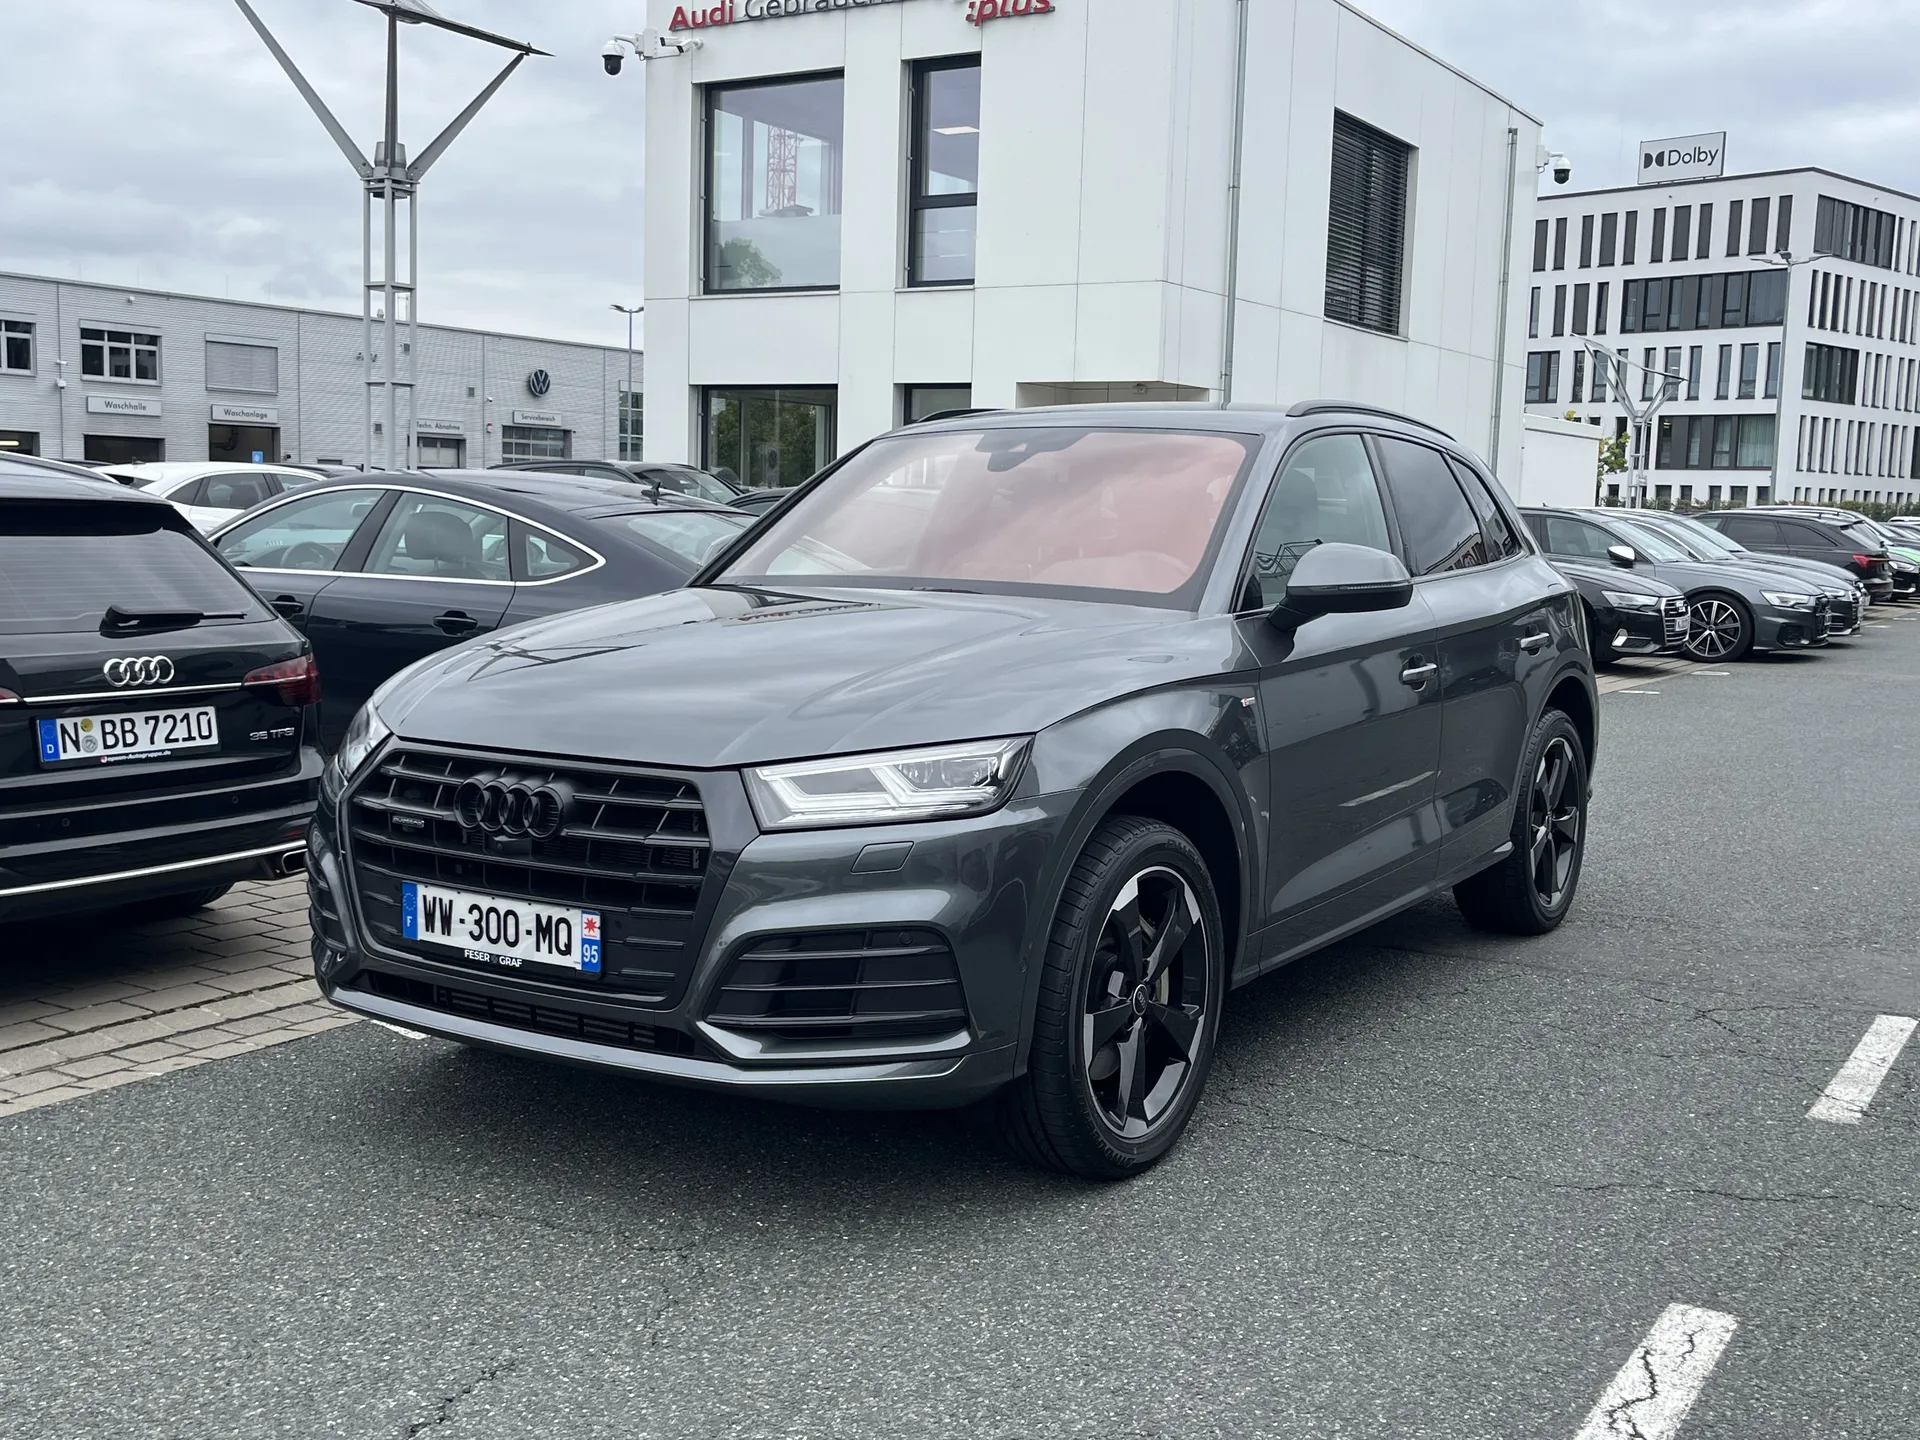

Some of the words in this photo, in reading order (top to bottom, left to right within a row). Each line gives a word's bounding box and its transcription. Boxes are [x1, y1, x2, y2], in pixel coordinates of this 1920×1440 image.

[668, 0, 735, 31] Audi
[1668, 146, 1719, 166] Dolby
[104, 401, 147, 411] Waschhalle
[223, 408, 268, 420] Waschanlage
[60, 722, 81, 753] N
[100, 717, 139, 750] BB
[144, 711, 213, 745] 7210
[47, 744, 55, 754] D
[406, 915, 412, 928] F
[464, 949, 490, 962] FESER
[499, 955, 522, 968] GRAF
[582, 943, 599, 964] 95
